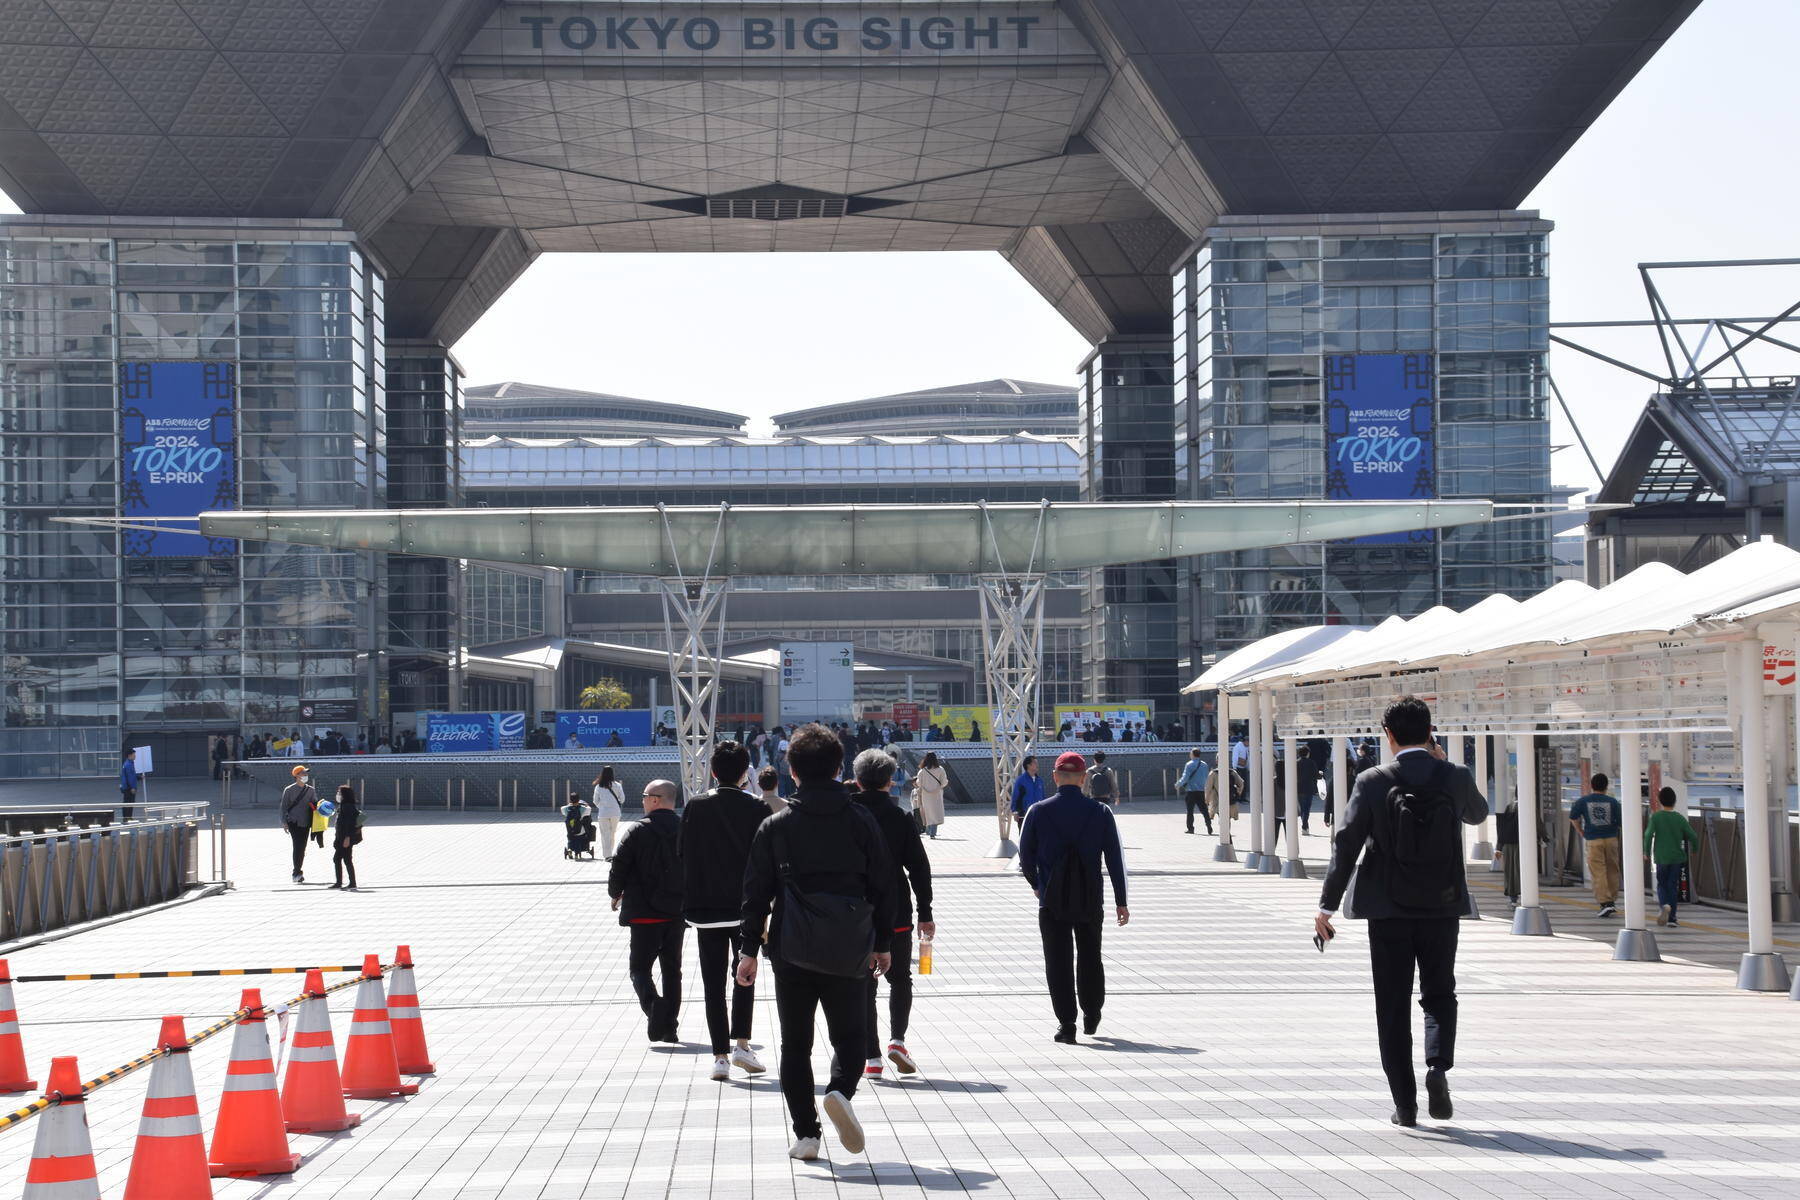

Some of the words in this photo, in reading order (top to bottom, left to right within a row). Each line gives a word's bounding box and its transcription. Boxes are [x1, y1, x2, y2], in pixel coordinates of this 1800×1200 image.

[520, 16, 721, 51] TOKYO
[744, 16, 840, 51] BIG
[861, 16, 1040, 51] SIGHT
[1358, 426, 1399, 438] 2024
[154, 436, 199, 448] 2024
[1336, 436, 1421, 462] TOKYO
[132, 446, 222, 472] TOKYO
[1353, 462, 1404, 473] E-PRIX
[150, 472, 204, 484] E-PRIX
[577, 715, 599, 725] 入口
